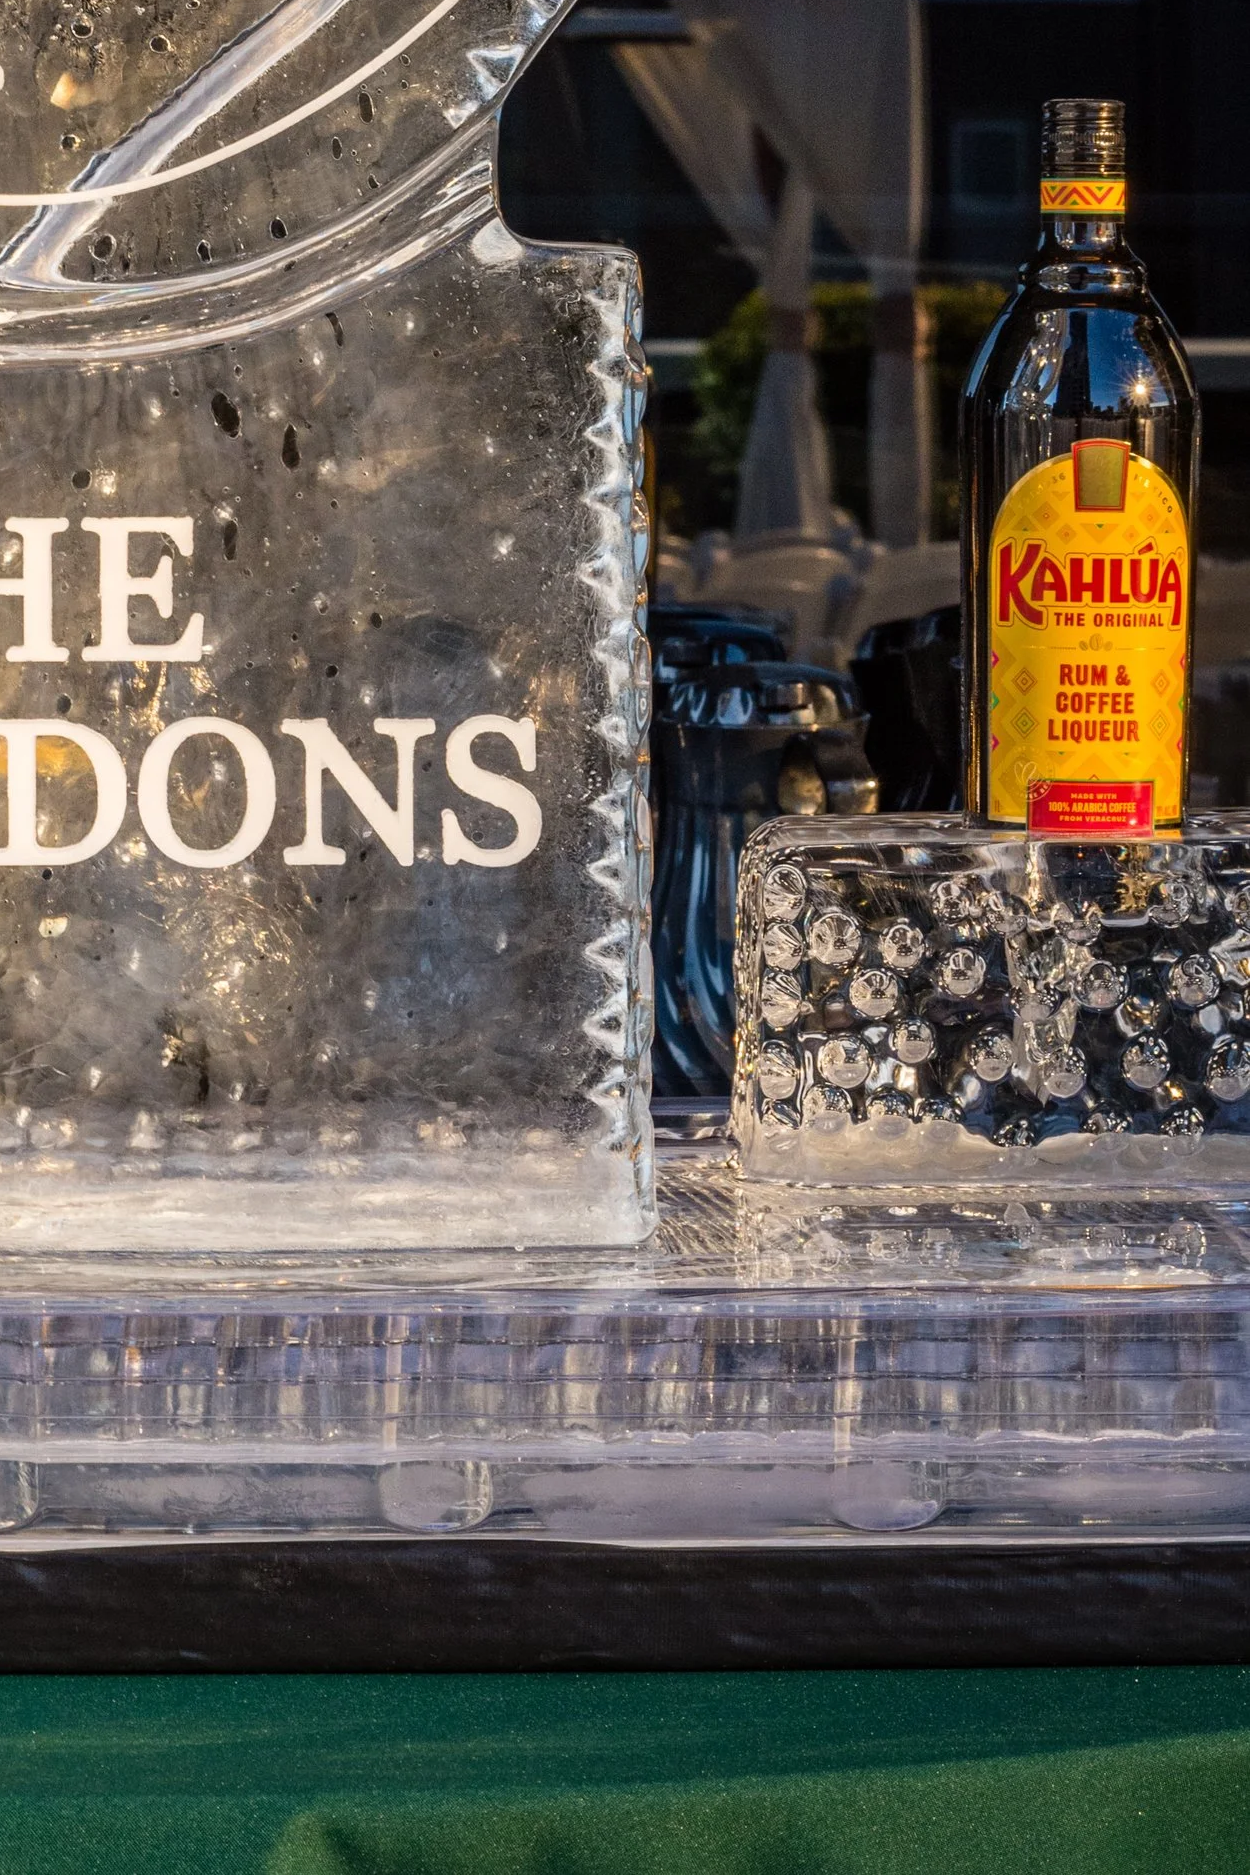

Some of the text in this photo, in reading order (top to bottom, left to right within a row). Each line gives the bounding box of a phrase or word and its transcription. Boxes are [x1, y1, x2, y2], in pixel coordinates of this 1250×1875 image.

[999, 541, 1182, 625] KAHLÚA
[1054, 612, 1164, 628] THE ORIGINAL
[1059, 663, 1131, 686] RUM &
[1055, 691, 1135, 714] COFFEE
[1047, 718, 1140, 744] LIQUEUR
[1070, 792, 1117, 800] MADE WITH
[1048, 801, 1137, 813] 100% ARABICA COFFEE
[1059, 814, 1127, 823] FROM VERACRUZ
